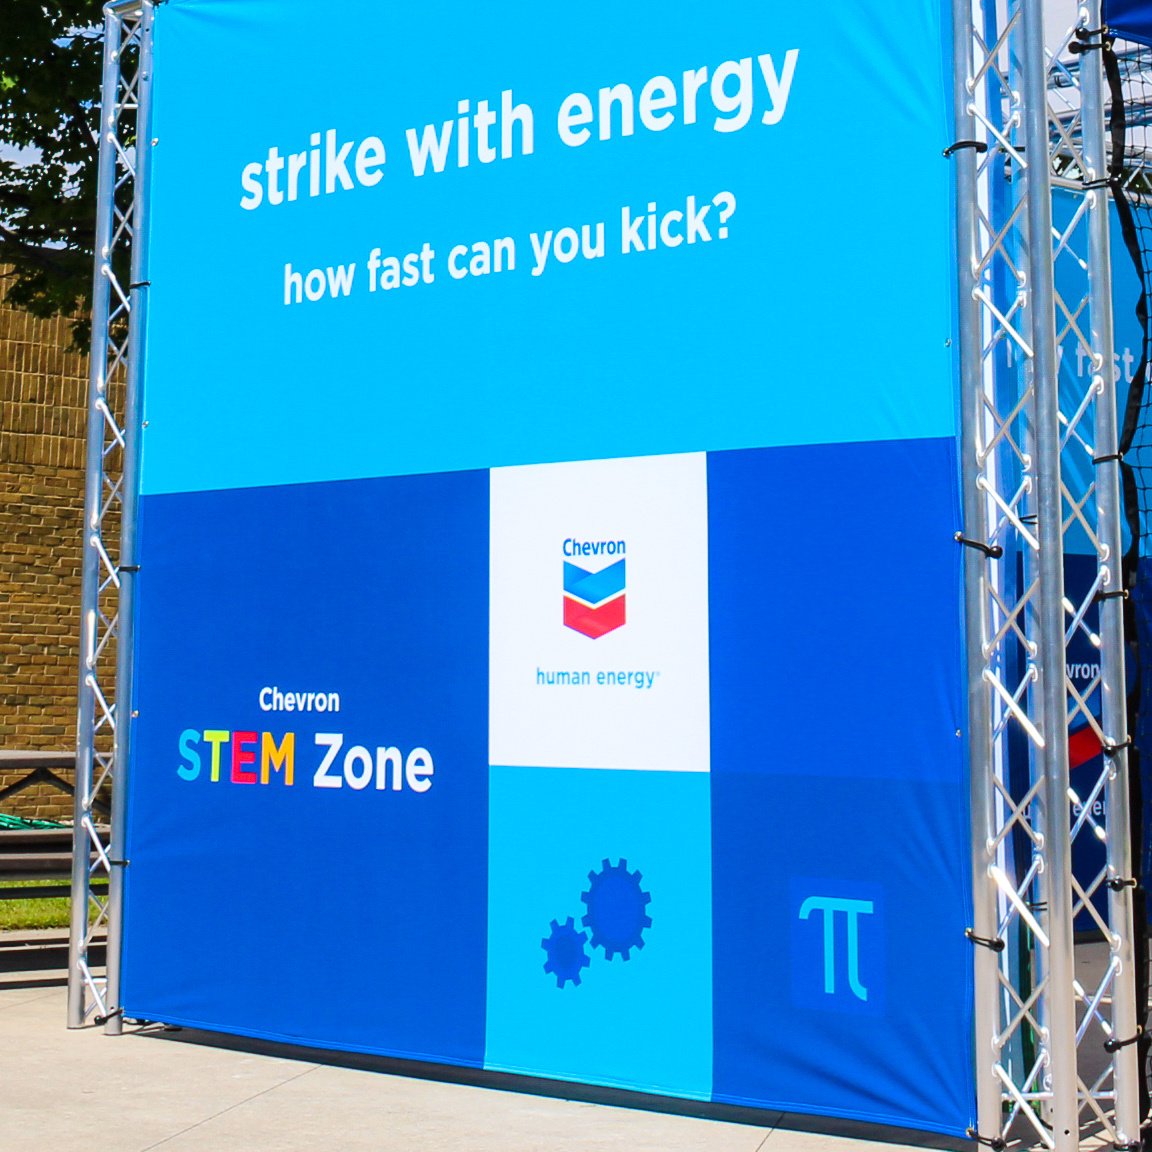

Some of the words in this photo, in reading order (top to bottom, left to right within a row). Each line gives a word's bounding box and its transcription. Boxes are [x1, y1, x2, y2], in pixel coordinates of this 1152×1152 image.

[239, 128, 386, 210] strike
[405, 89, 534, 177] with
[557, 48, 800, 147] energy
[283, 260, 356, 305] how
[366, 243, 435, 293] fast
[447, 236, 516, 279] can
[529, 222, 605, 276] you
[621, 191, 737, 254] kick?
[562, 538, 626, 556] Chevron
[259, 686, 340, 712] Chevron
[536, 667, 591, 686] human
[596, 670, 655, 689] energy
[177, 729, 295, 786] STEM
[313, 733, 434, 793] Zone
